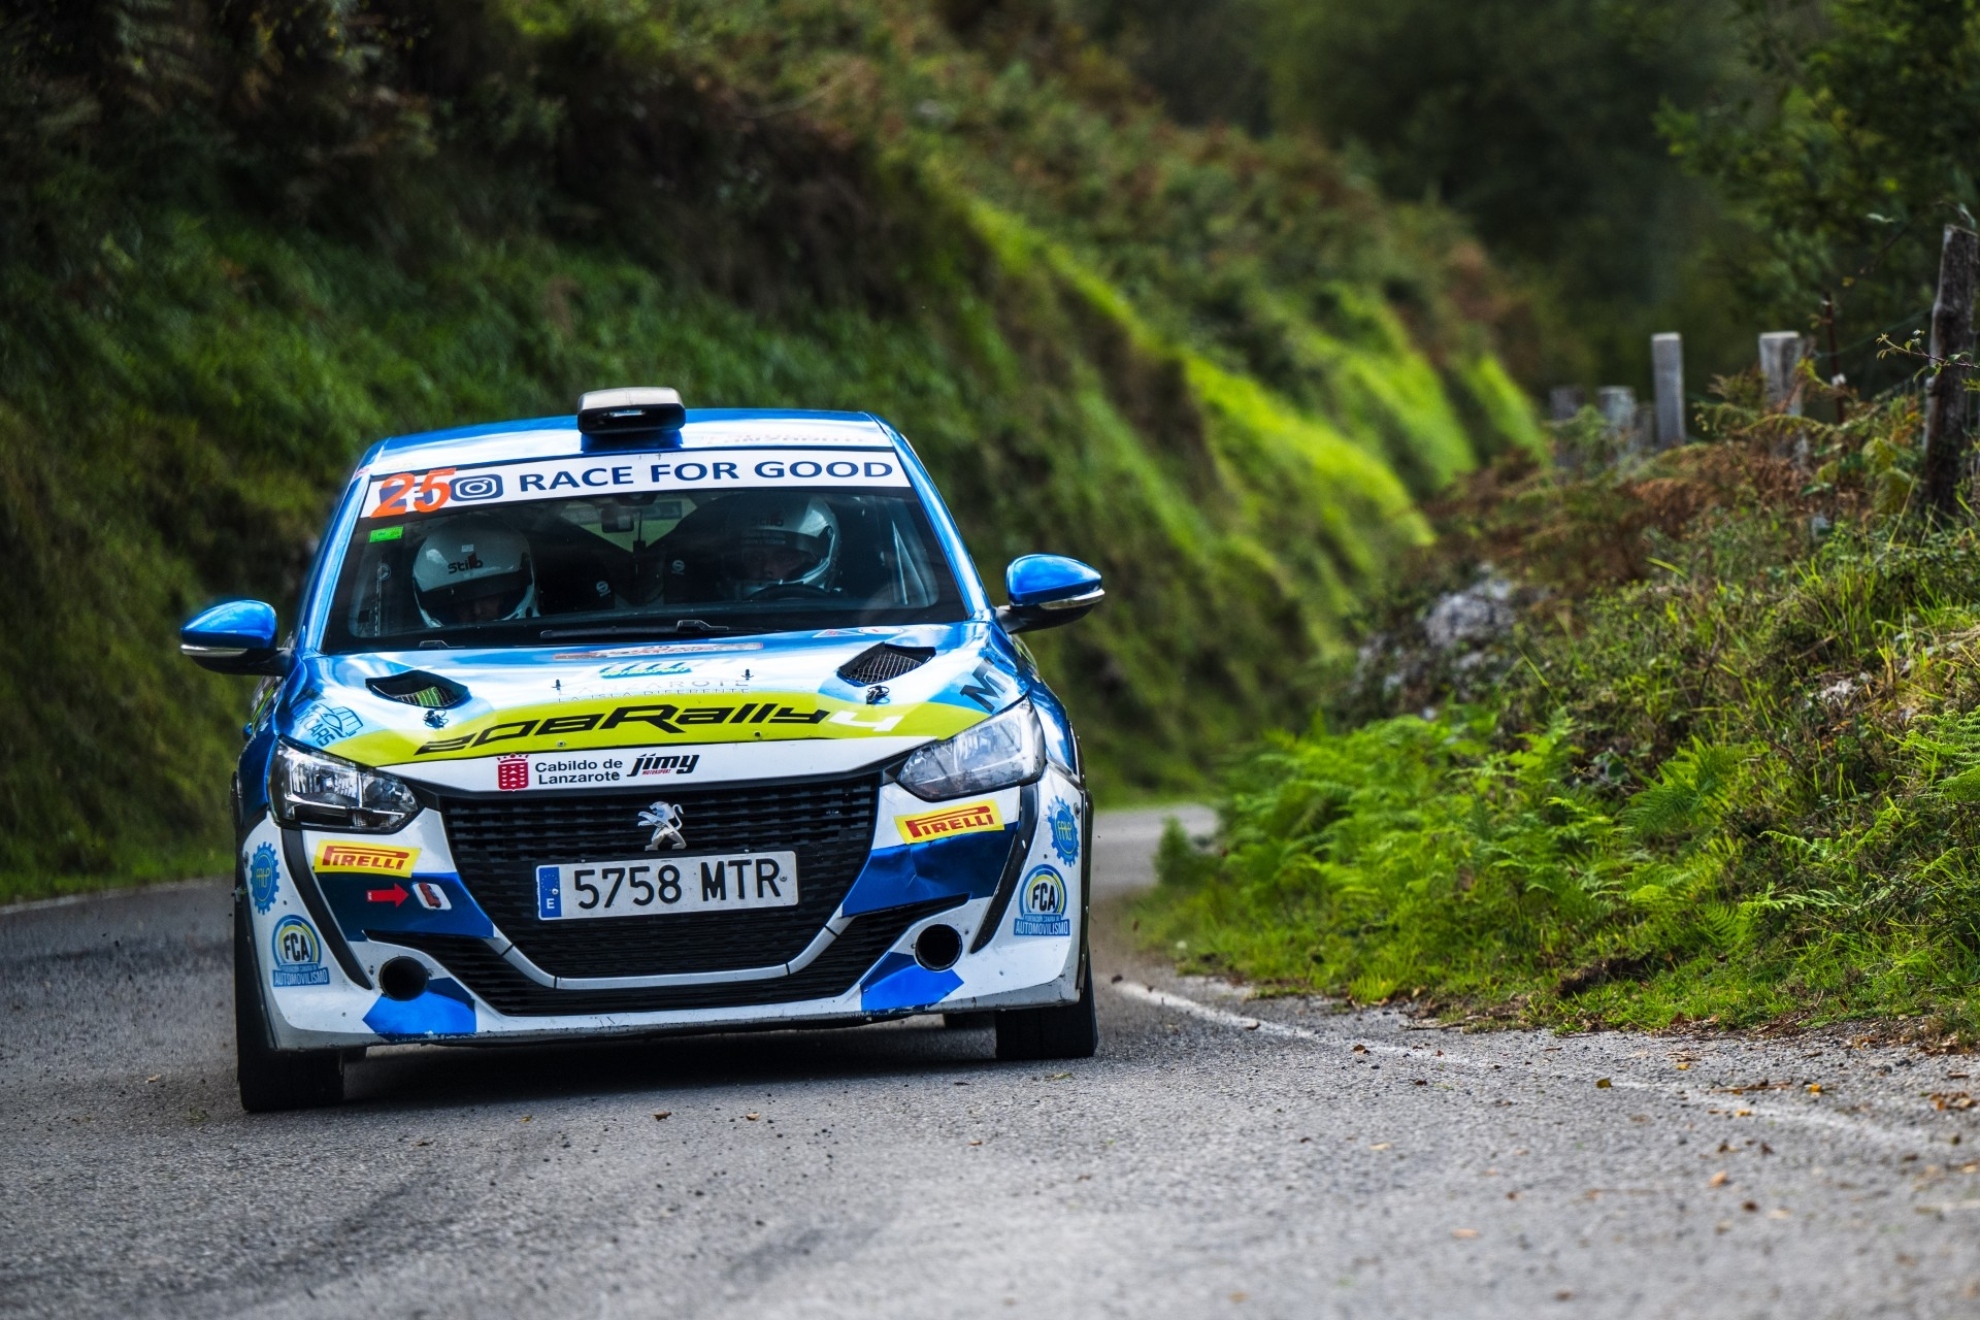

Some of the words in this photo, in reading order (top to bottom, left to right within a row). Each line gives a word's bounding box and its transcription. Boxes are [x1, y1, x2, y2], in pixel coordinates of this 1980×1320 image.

[519, 466, 634, 492] RACE
[650, 462, 740, 483] FOR
[754, 461, 893, 478] GOOD
[370, 467, 457, 518] 25
[535, 760, 598, 773] Cabildo
[602, 758, 623, 770] de
[538, 771, 621, 785] Lanzarote
[905, 805, 994, 839] PIRELLI
[322, 845, 410, 870] PIRELLI
[574, 864, 683, 910] 5758
[700, 858, 782, 902] MTR
[1032, 882, 1056, 912] FCA
[546, 898, 555, 909] E
[1016, 921, 1069, 935] AUTOMOVILISMO
[283, 933, 310, 961] FCA
[274, 968, 328, 985] AUTOMOVILISMO
